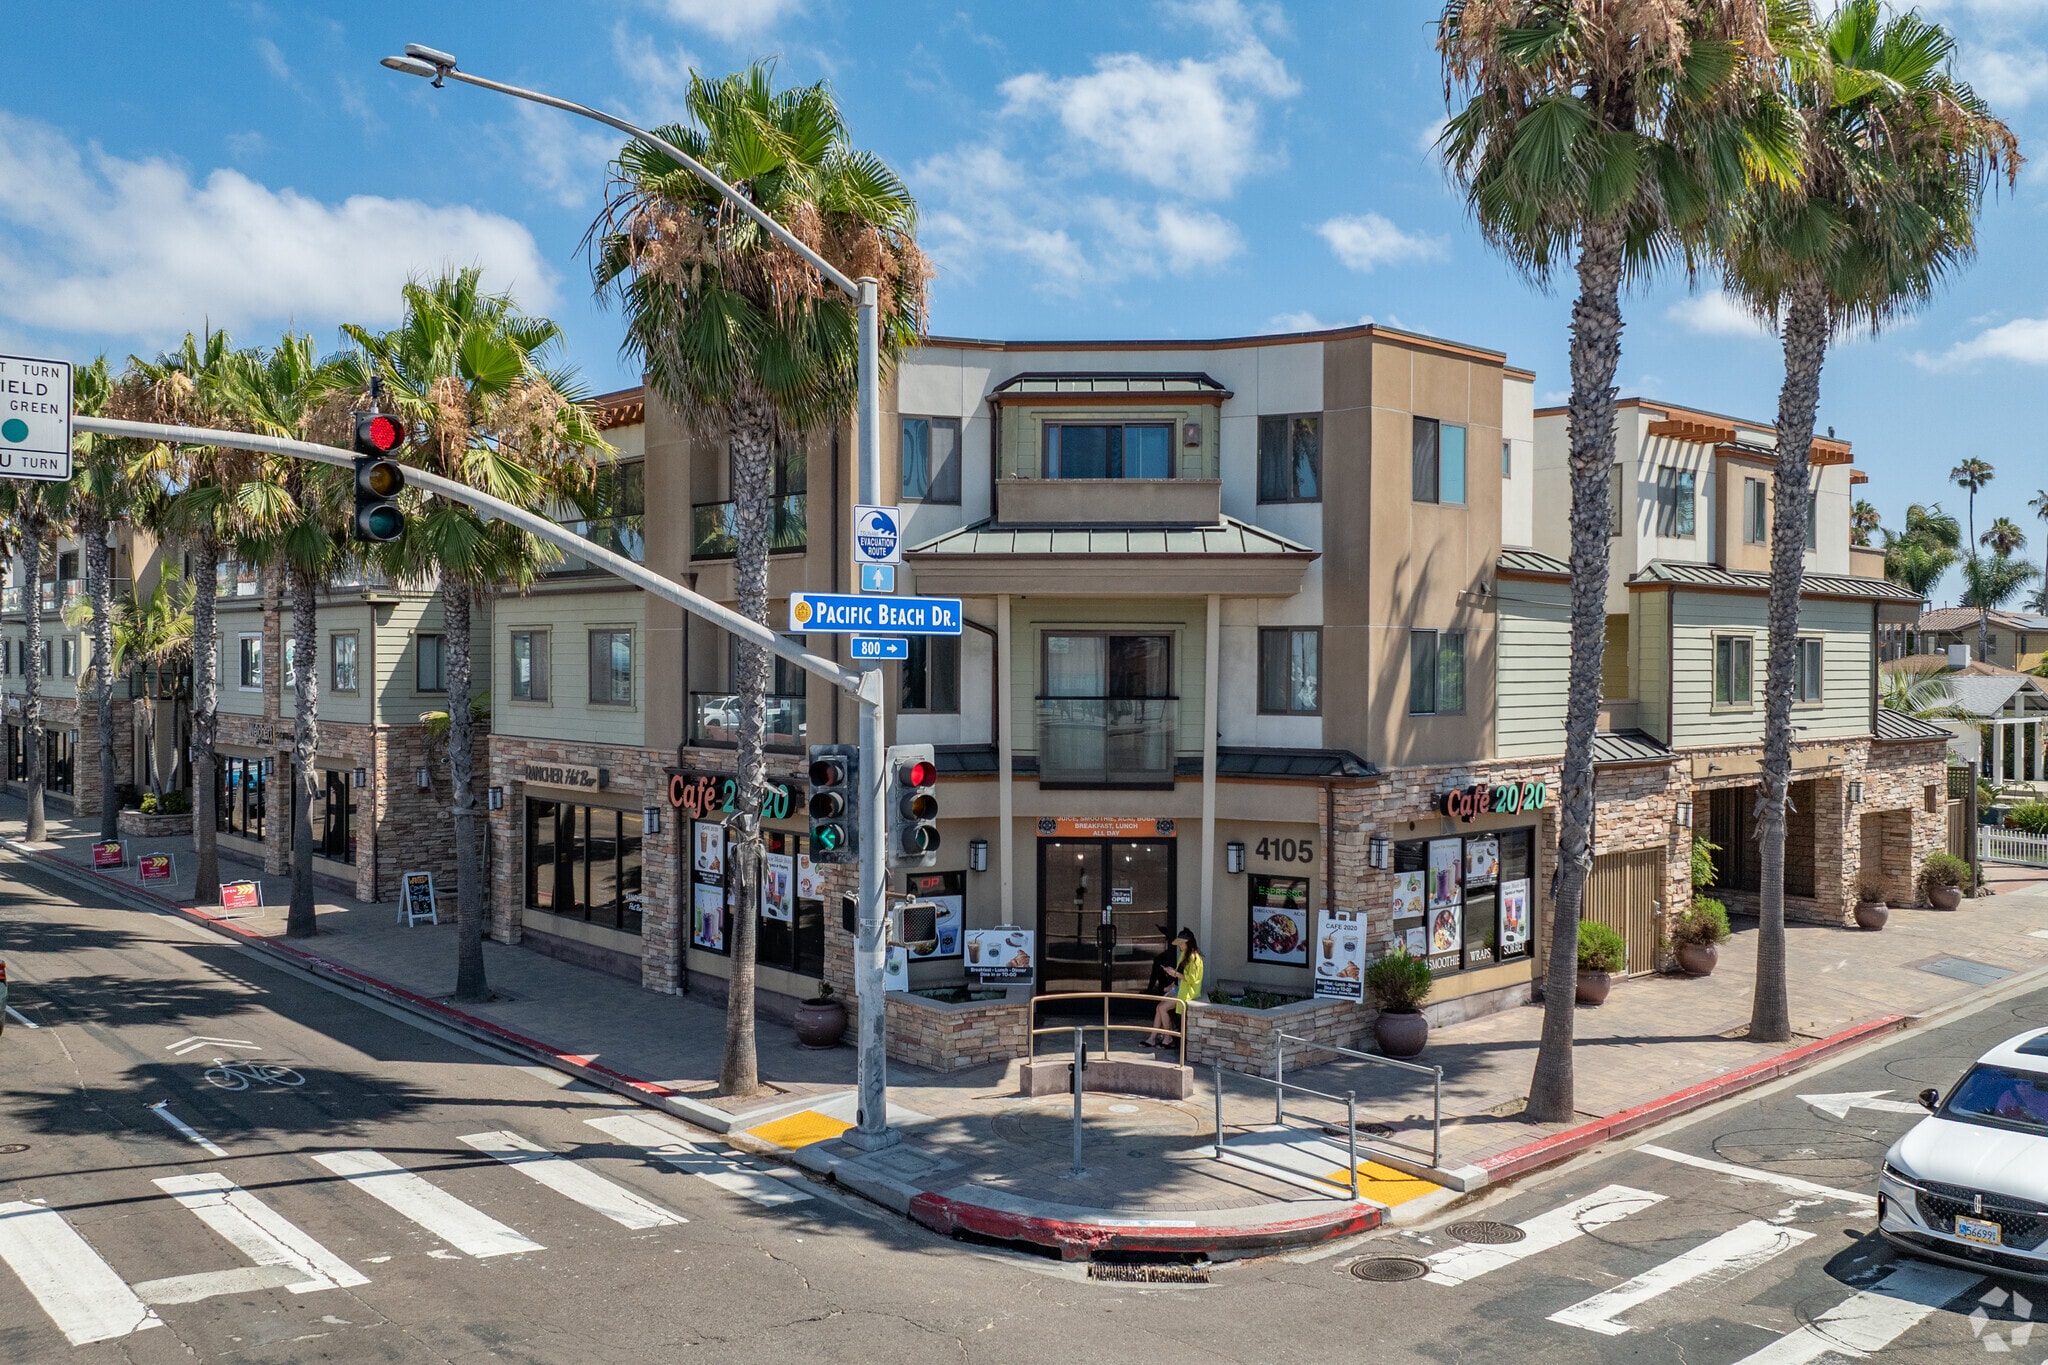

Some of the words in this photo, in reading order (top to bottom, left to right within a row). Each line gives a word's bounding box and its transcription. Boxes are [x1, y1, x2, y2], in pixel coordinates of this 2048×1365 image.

[22, 364, 59, 378] TURN
[0, 379, 48, 396] IELD
[10, 400, 59, 415] GREEN
[0, 454, 11, 467] U
[22, 457, 58, 469] TURN
[860, 537, 894, 547] EVACUATION
[868, 546, 887, 556] ROUTE
[861, 641, 881, 656] 800
[525, 764, 563, 784] RANCHER
[670, 775, 716, 819] Café
[1447, 783, 1490, 823] Café
[1495, 782, 1546, 816] 20/20
[1255, 837, 1314, 863] 4105
[1343, 924, 1358, 932] 2020
[1428, 954, 1460, 971] SMOOTHIE
[1469, 948, 1492, 962] WRAPS
